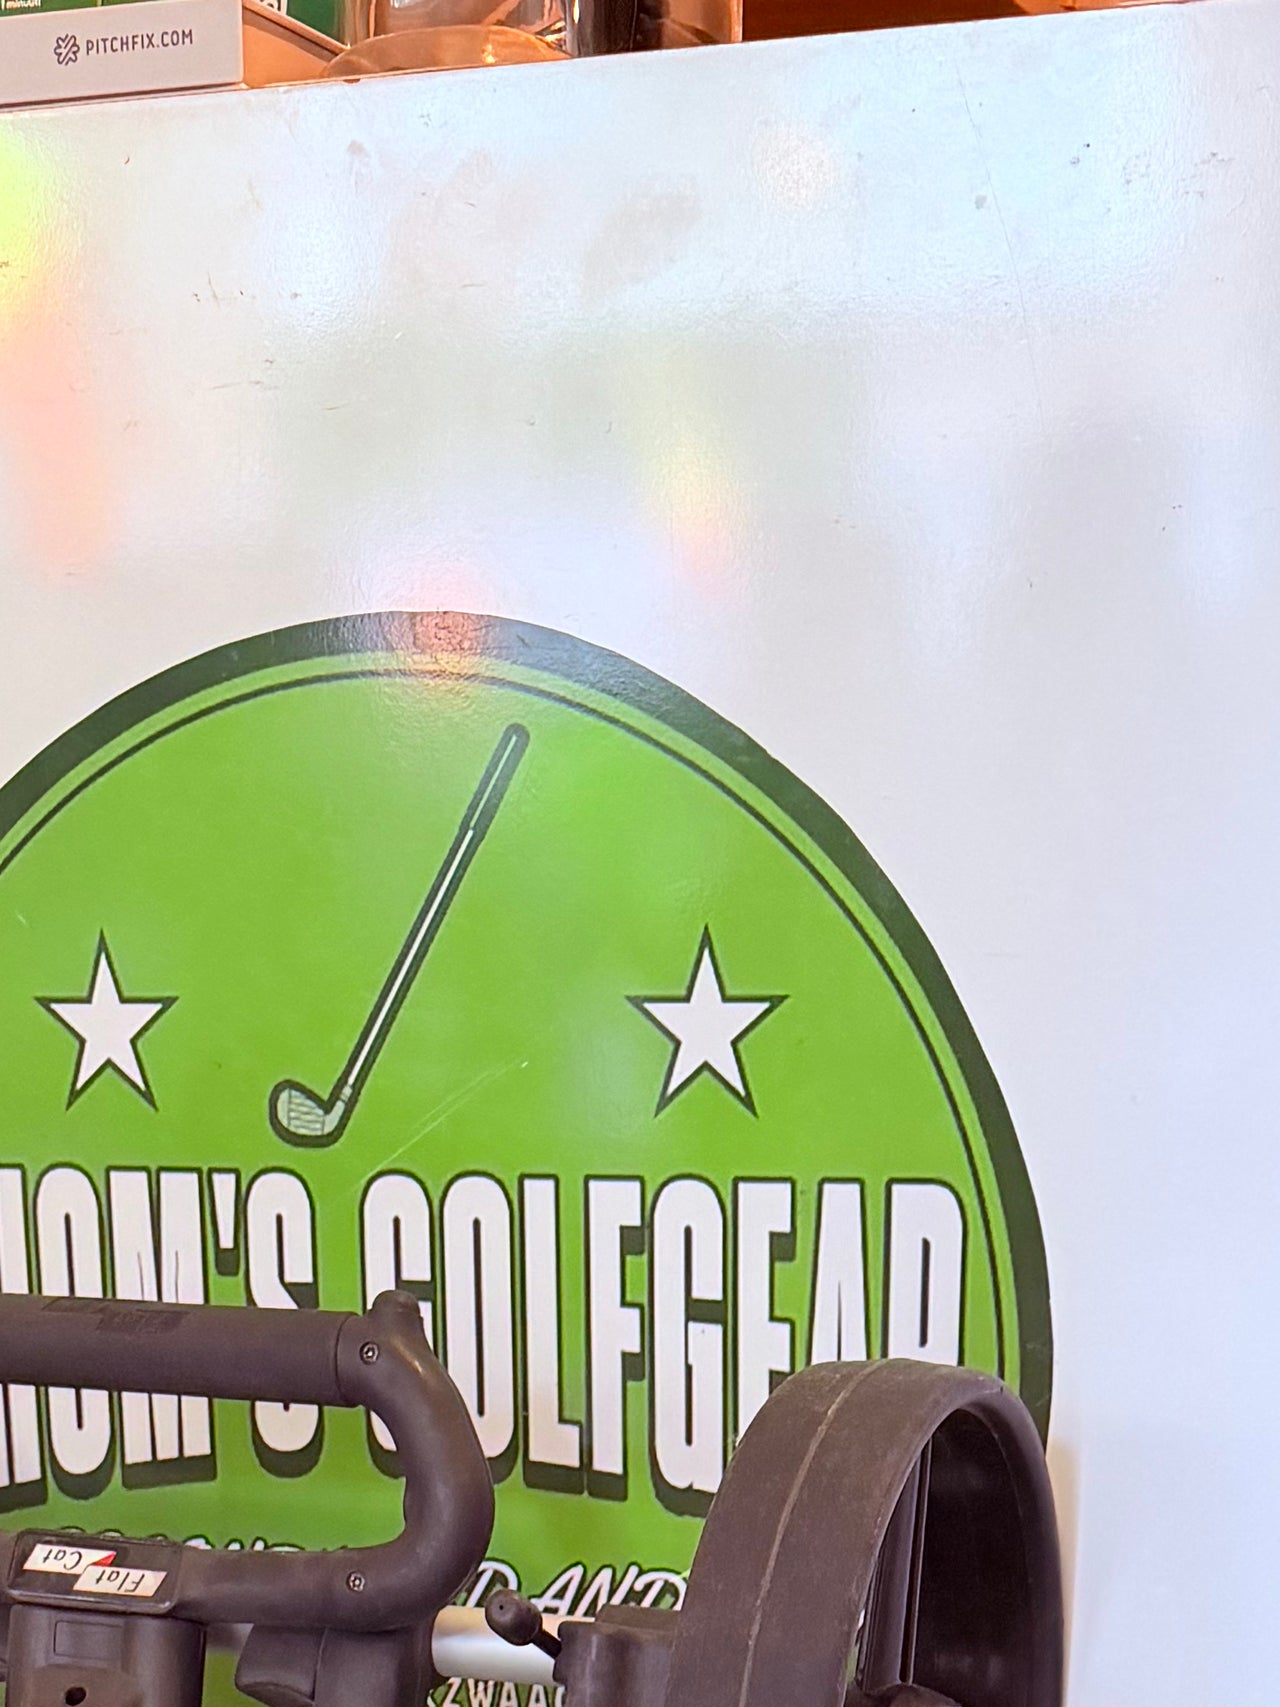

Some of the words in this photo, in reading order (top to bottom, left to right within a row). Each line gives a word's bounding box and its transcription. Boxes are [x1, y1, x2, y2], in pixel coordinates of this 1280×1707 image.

[85, 29, 194, 56] PITCHFIX.COM
[42, 1548, 83, 1571] Cat
[96, 1569, 146, 1593] Flat
